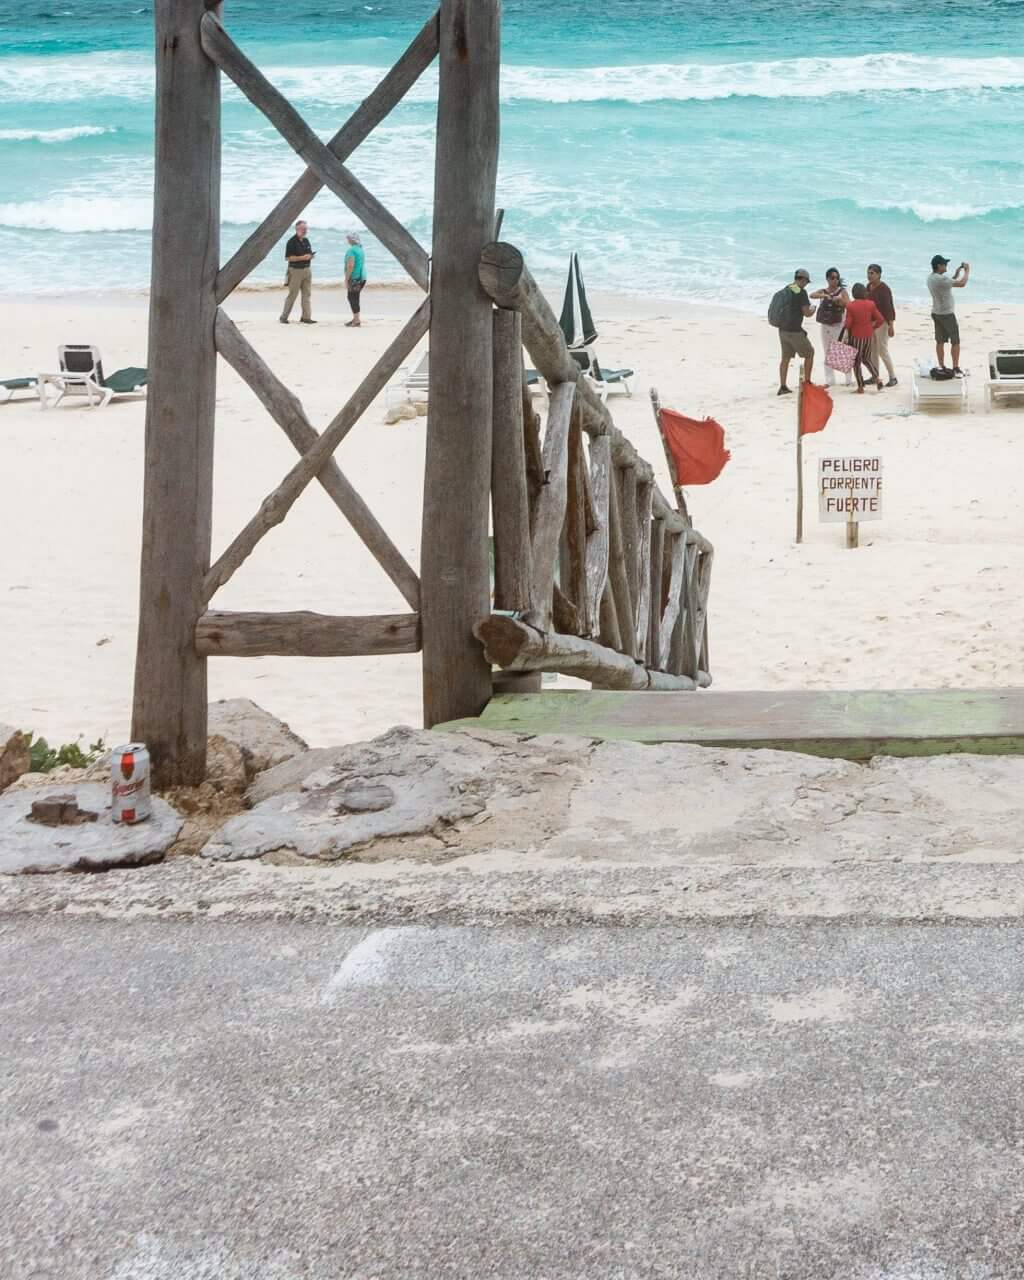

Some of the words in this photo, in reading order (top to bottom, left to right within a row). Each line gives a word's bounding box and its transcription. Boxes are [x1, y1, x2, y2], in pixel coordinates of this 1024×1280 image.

[822, 458, 879, 472] PELIGRO
[822, 477, 882, 490] CORRIENTE
[827, 497, 878, 512] FUERTE
